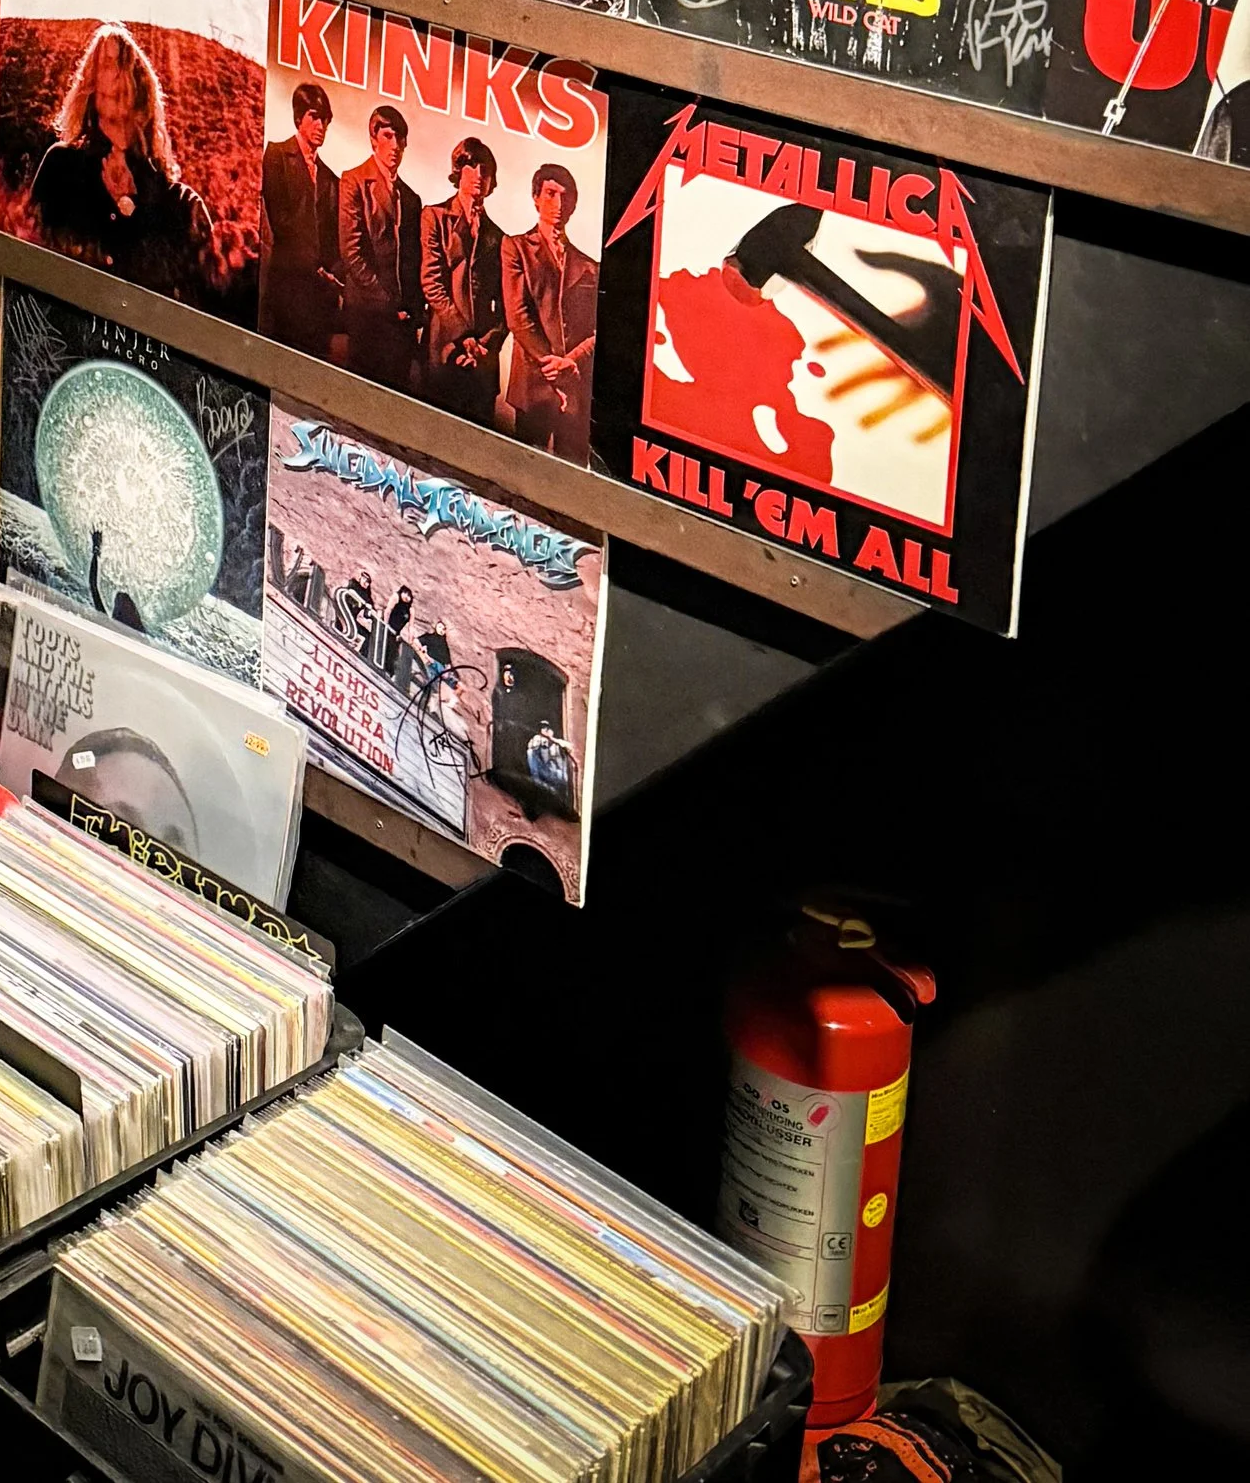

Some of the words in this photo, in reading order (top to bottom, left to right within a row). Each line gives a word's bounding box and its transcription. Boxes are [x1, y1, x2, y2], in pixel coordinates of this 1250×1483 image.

[863, 8, 902, 36] CAT
[605, 102, 1026, 386] METALLICA
[91, 315, 171, 363] JINJER
[101, 339, 159, 372] MACRO
[632, 435, 734, 519] KILL
[852, 524, 959, 605] ALL
[20, 613, 81, 662] TOOTS
[299, 663, 386, 741] CAMERA
[312, 641, 381, 712] LIGHTS
[285, 679, 395, 776] REVOLUTION
[103, 1358, 188, 1445] JOY
